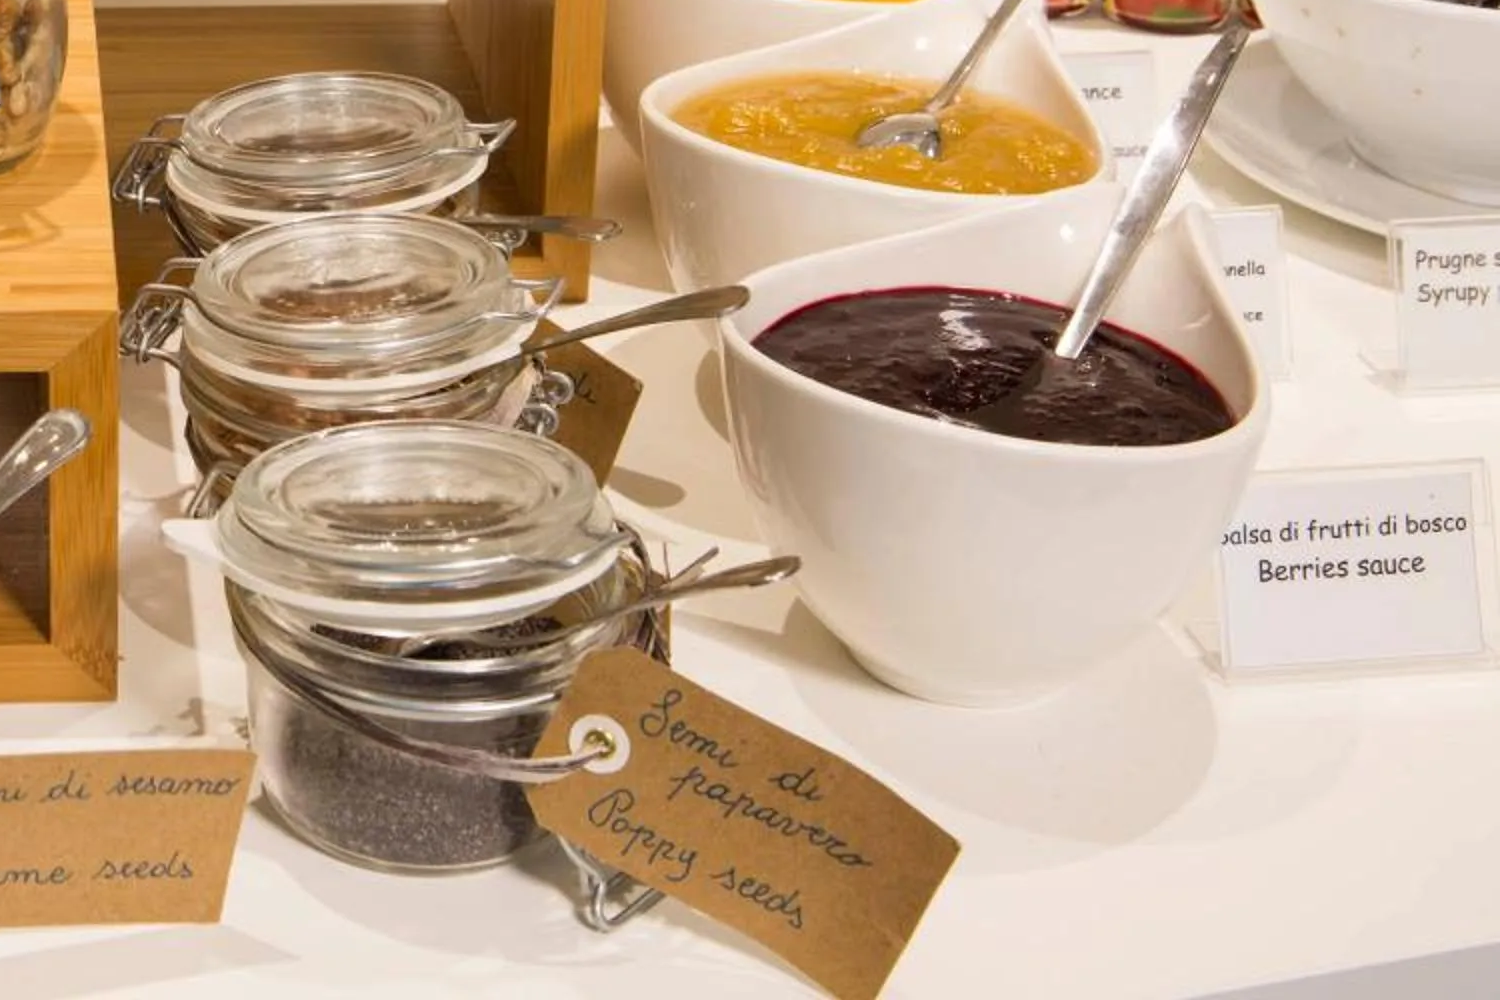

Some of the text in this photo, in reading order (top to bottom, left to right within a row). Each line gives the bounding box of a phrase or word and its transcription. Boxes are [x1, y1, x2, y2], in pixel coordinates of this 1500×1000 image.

[1415, 249, 1487, 274] Prugne
[1416, 283, 1491, 308] Syrupy
[1279, 521, 1299, 543] di
[1307, 518, 1370, 542] frutti
[1378, 515, 1397, 536] di
[1405, 514, 1467, 536] bosco
[1258, 555, 1425, 583] Berries sauce
[638, 688, 834, 804] Semi di
[40, 769, 92, 802] di
[107, 775, 241, 798] sesamo
[670, 765, 873, 871] papavero
[94, 851, 194, 882] seeds
[587, 787, 804, 931] Poppy seeds
